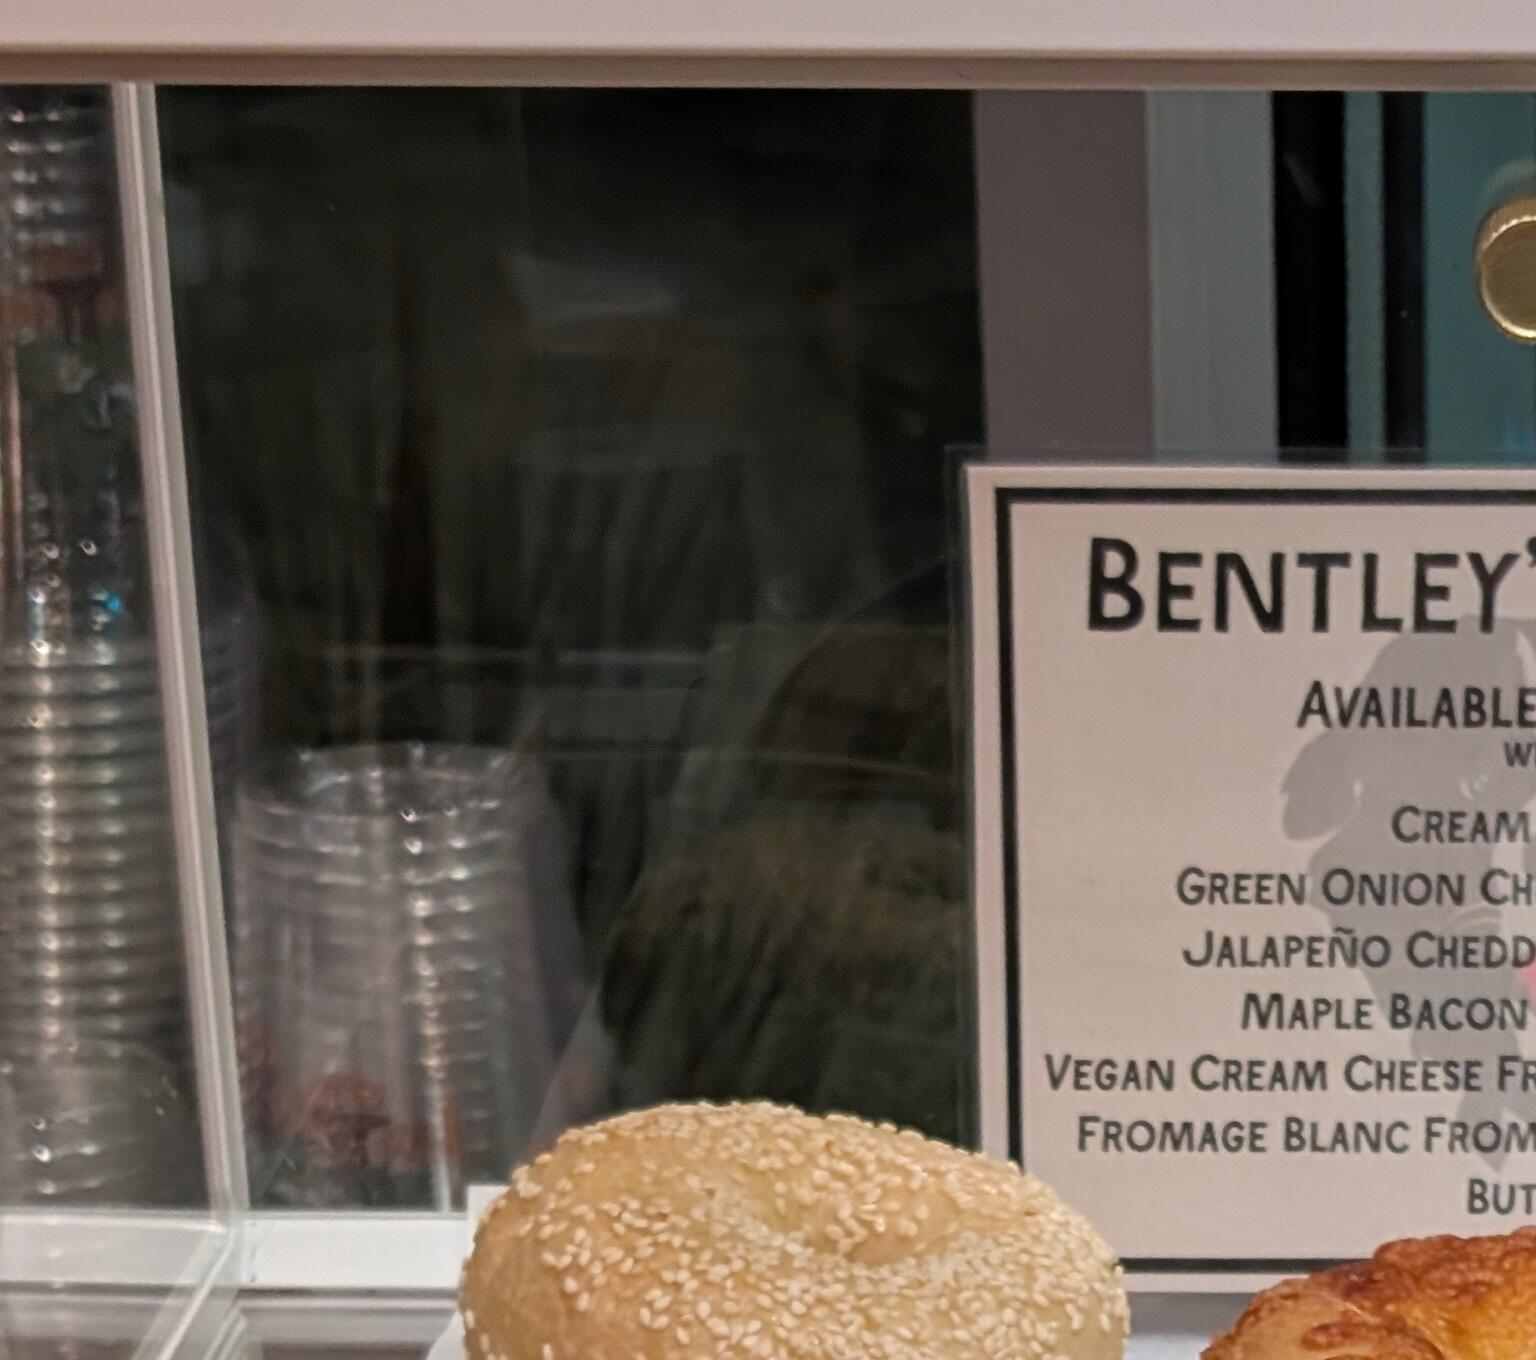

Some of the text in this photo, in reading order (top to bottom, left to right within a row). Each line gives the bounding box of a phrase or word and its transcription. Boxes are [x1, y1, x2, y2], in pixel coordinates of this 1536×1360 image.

[1393, 806, 1531, 845] CREAM
[1176, 867, 1306, 907] GREEN
[1322, 867, 1465, 907] ONION
[1241, 993, 1372, 1031] MAPLE
[1390, 993, 1527, 1031] BACON
[1045, 1054, 1174, 1093] VEGAN
[1191, 1054, 1327, 1093] CREAM
[1344, 1054, 1482, 1093] CHEESE
[1078, 1115, 1265, 1154] FROMAGE
[1283, 1115, 1407, 1154] BLANC
